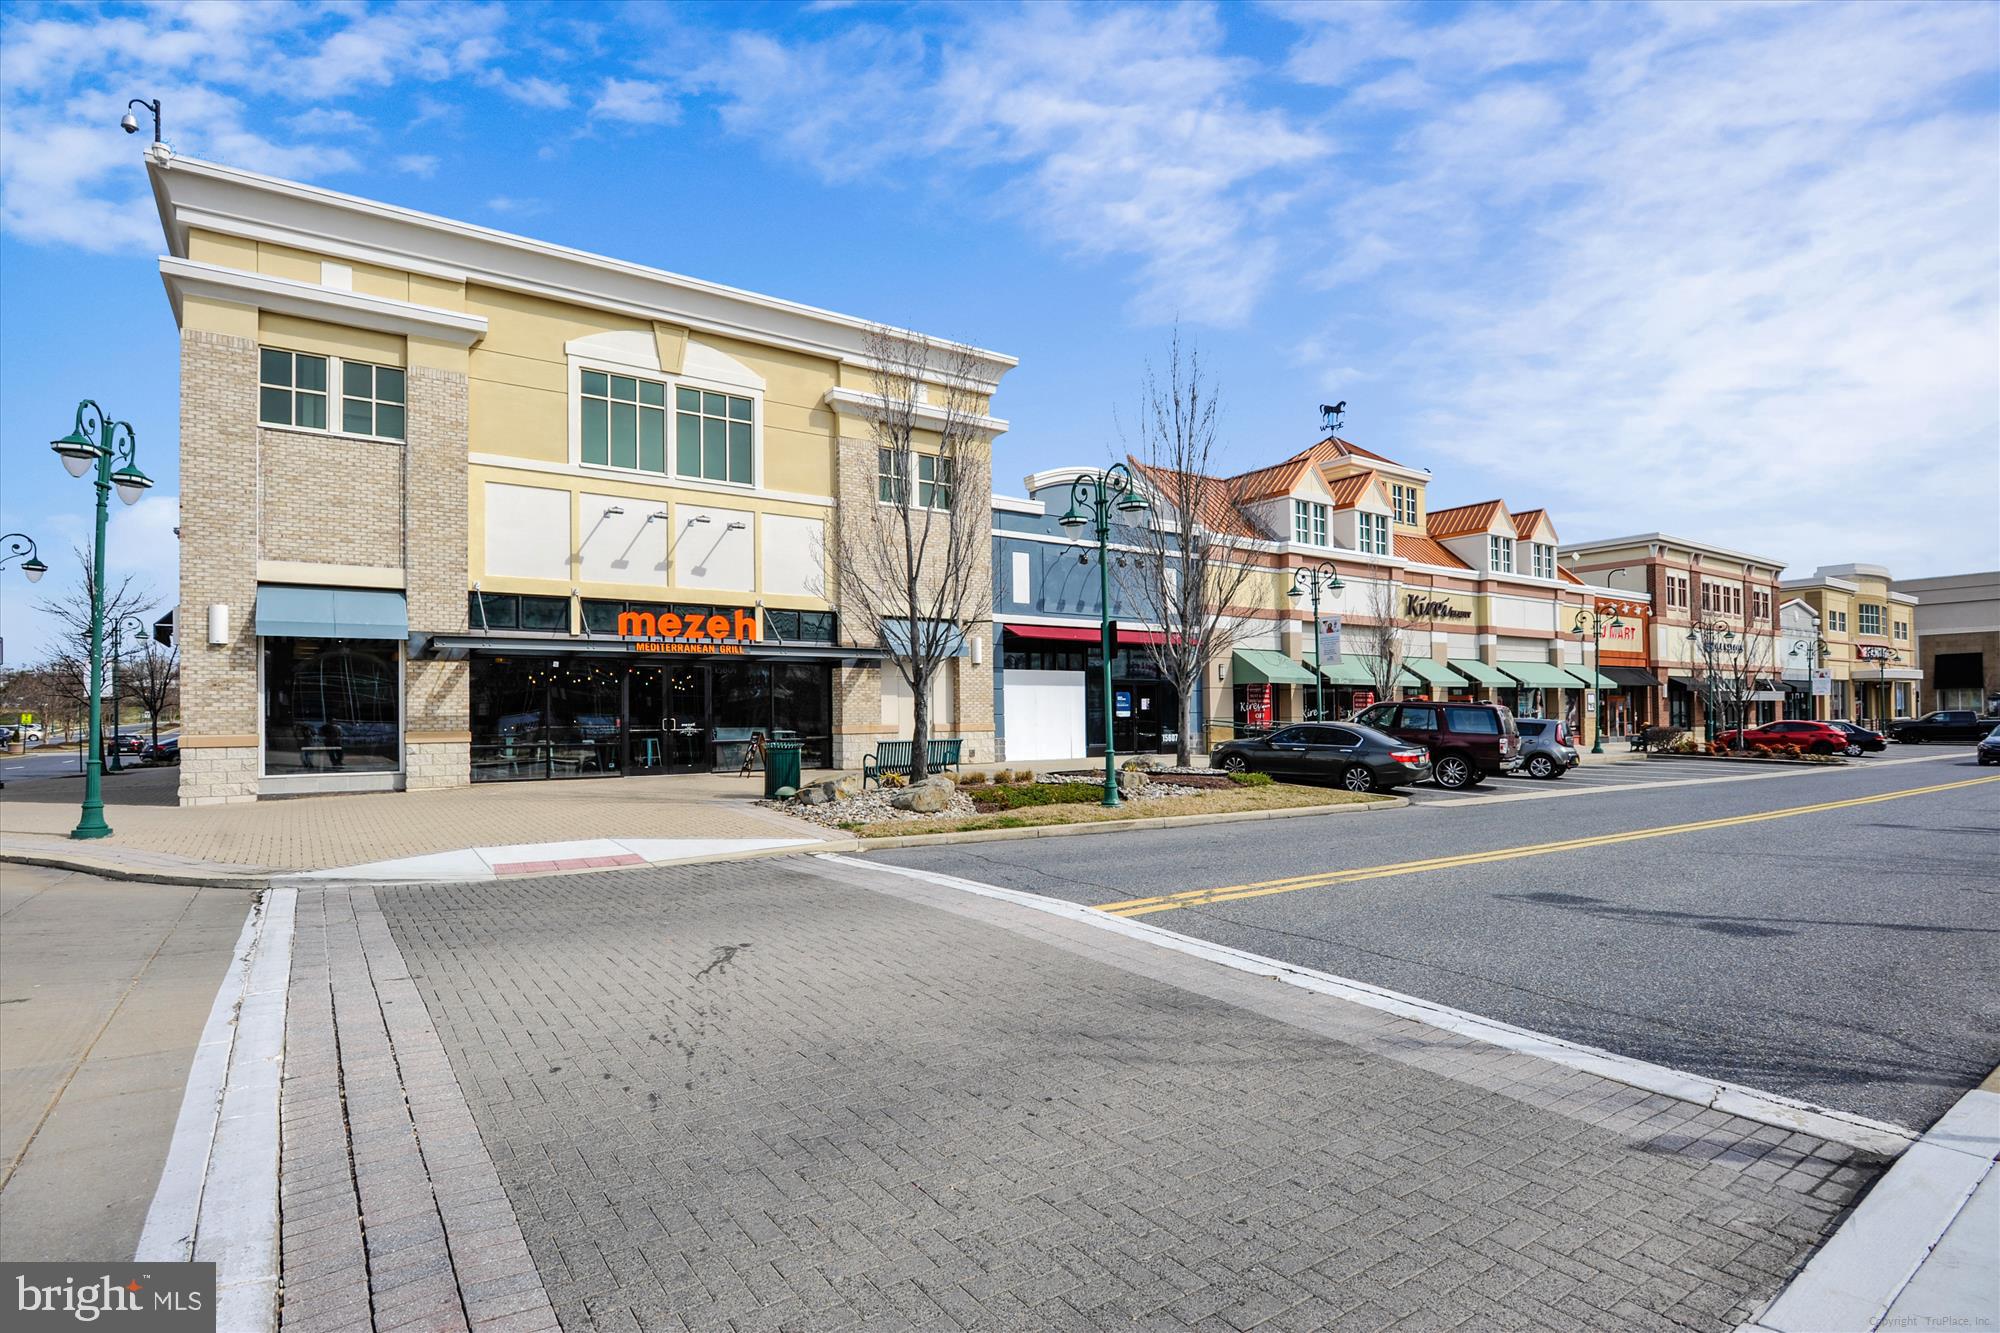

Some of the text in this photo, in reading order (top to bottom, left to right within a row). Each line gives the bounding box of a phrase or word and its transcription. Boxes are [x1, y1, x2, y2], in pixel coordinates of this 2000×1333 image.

[618, 608, 756, 641] mezeh
[1609, 626, 1636, 639] MART
[636, 642, 745, 654] MEDITERRANEAN GRILL
